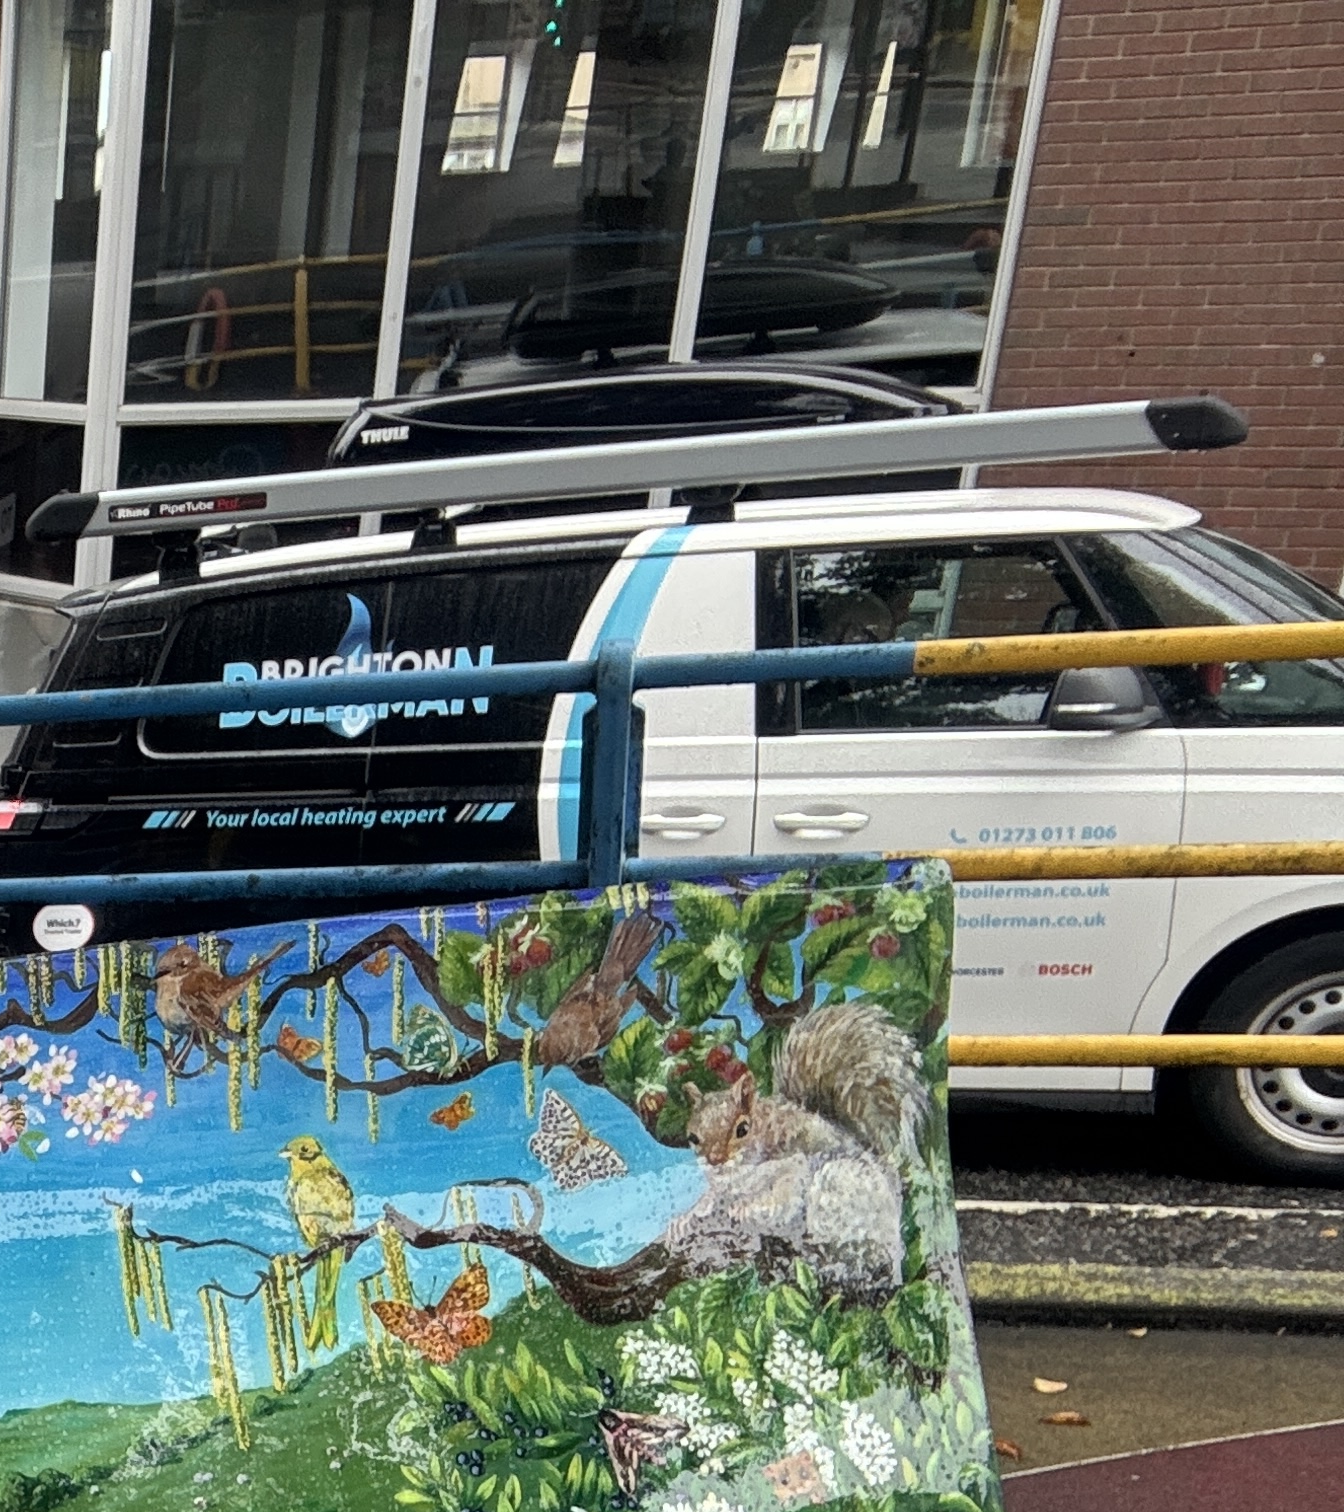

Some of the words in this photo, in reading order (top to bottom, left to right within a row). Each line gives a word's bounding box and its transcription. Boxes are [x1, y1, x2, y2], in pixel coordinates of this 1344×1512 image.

[361, 426, 410, 444] THULE
[117, 505, 150, 518] Rhino
[159, 499, 214, 515] PipeTube
[261, 648, 452, 682] BRIGHTON
[205, 809, 249, 829] Your
[250, 808, 297, 827] local
[300, 806, 377, 829] heating
[380, 805, 446, 828] expert
[978, 827, 1037, 843] 01273
[1040, 826, 1075, 842] 011
[956, 883, 1110, 900] boilerman.co.uk
[952, 966, 1005, 977] ORCESTER
[1038, 963, 1094, 977] BOSCH
